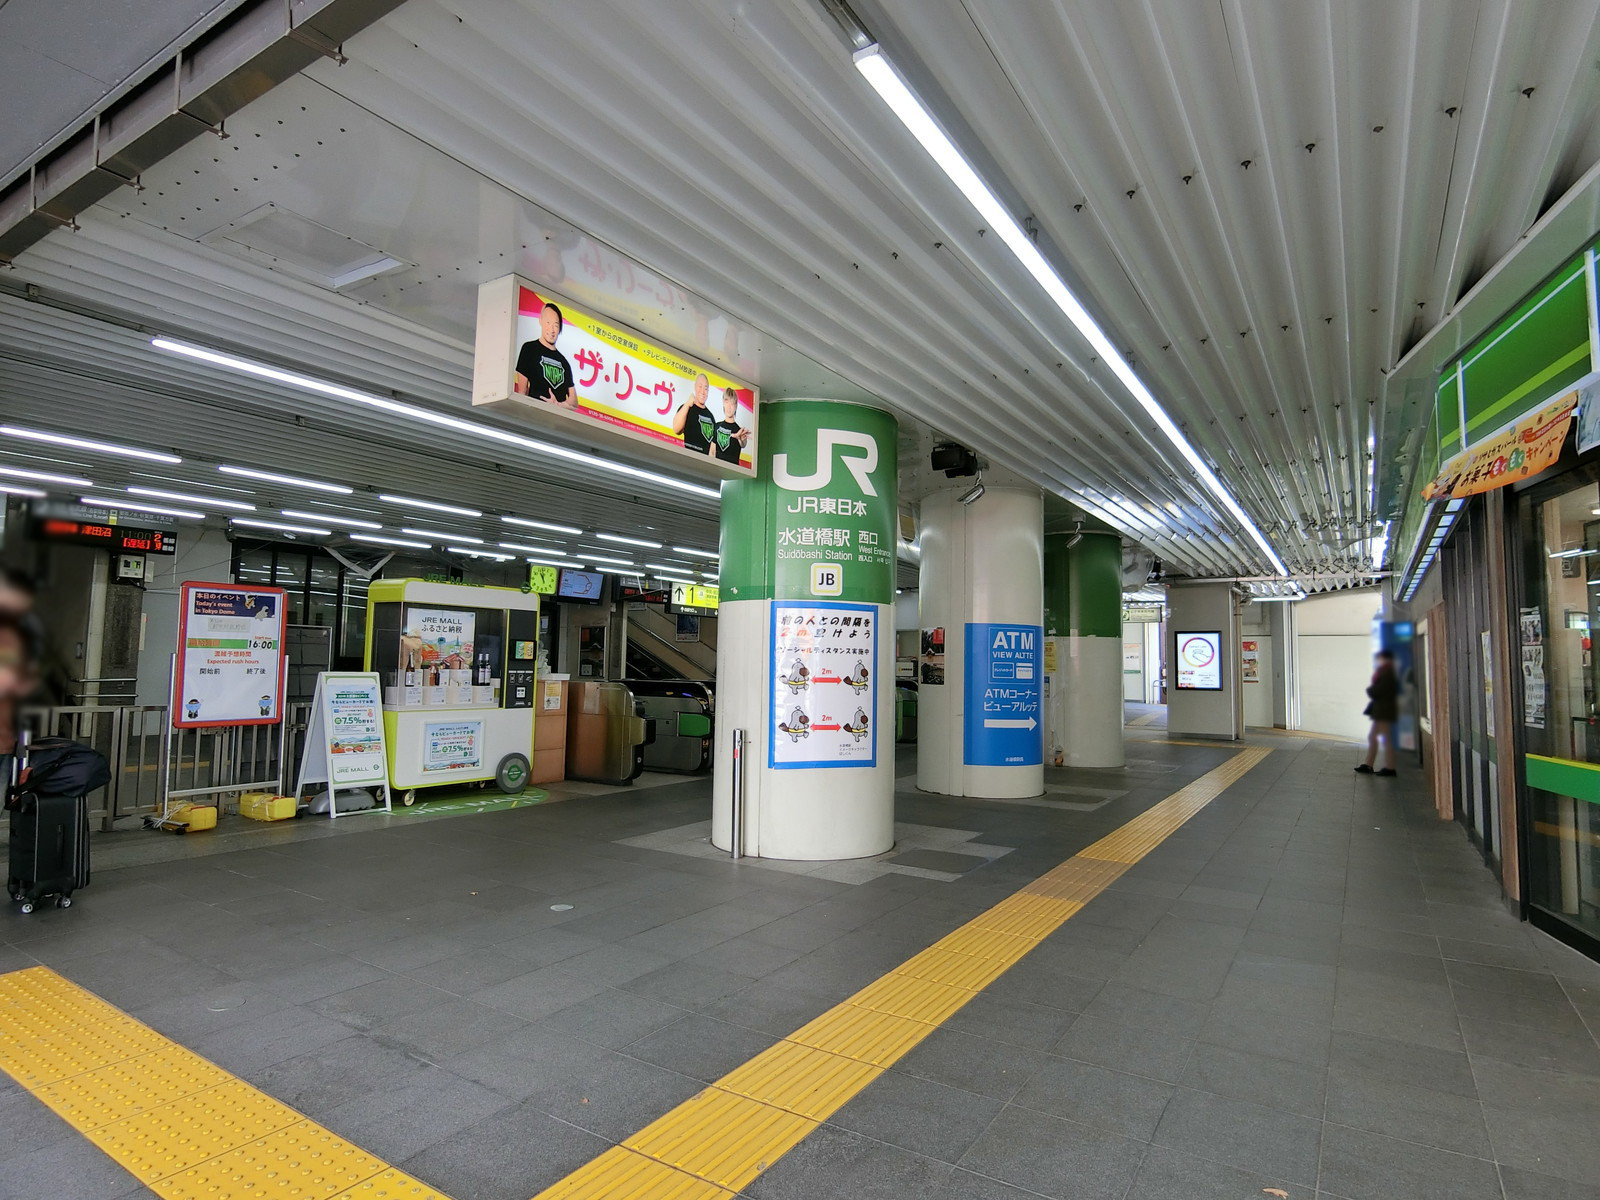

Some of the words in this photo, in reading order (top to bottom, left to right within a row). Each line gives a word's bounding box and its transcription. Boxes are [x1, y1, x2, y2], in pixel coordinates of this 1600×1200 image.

[574, 347, 675, 416] ザ・リーヴ
[772, 428, 879, 497] JR
[787, 496, 867, 517] JR東日本
[121, 530, 152, 540] 11:00
[778, 527, 851, 547] 水道橋駅
[858, 530, 878, 546] 西口
[778, 548, 823, 560] Suidōbashi
[825, 549, 853, 561] Station
[858, 545, 873, 554] West
[818, 572, 835, 586] JB
[196, 592, 241, 602] 本日のイベント
[689, 586, 695, 604] 1
[421, 616, 438, 624] JRE
[439, 617, 463, 625] MALL
[781, 615, 871, 628] 前の人との間隔を
[421, 624, 463, 634] ふるさと納税
[248, 640, 273, 649] 16:00
[992, 631, 1033, 650] ATM
[992, 651, 1012, 659] VIEW
[1015, 651, 1034, 660] ALTTE
[984, 688, 1038, 699] ATMコーナー
[984, 701, 1038, 712] ビューアルッテ
